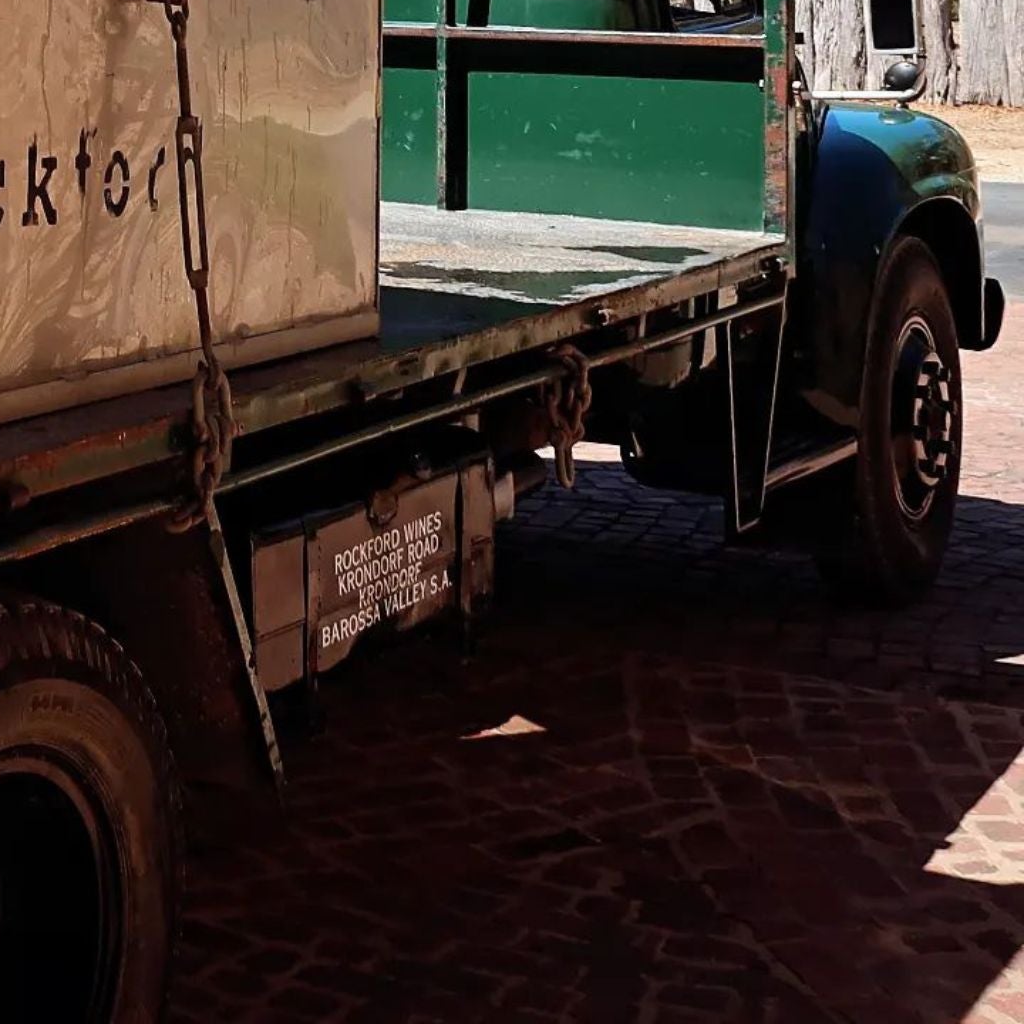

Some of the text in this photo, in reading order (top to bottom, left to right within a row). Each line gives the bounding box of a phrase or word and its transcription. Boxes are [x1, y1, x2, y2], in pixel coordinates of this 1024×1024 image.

[335, 511, 442, 575] ROCKFORD WINES
[338, 534, 439, 596] KRONDORF ROAD
[322, 570, 453, 648] BAROSSA VALLEY S.A.
[359, 561, 422, 608] KRONDORF
